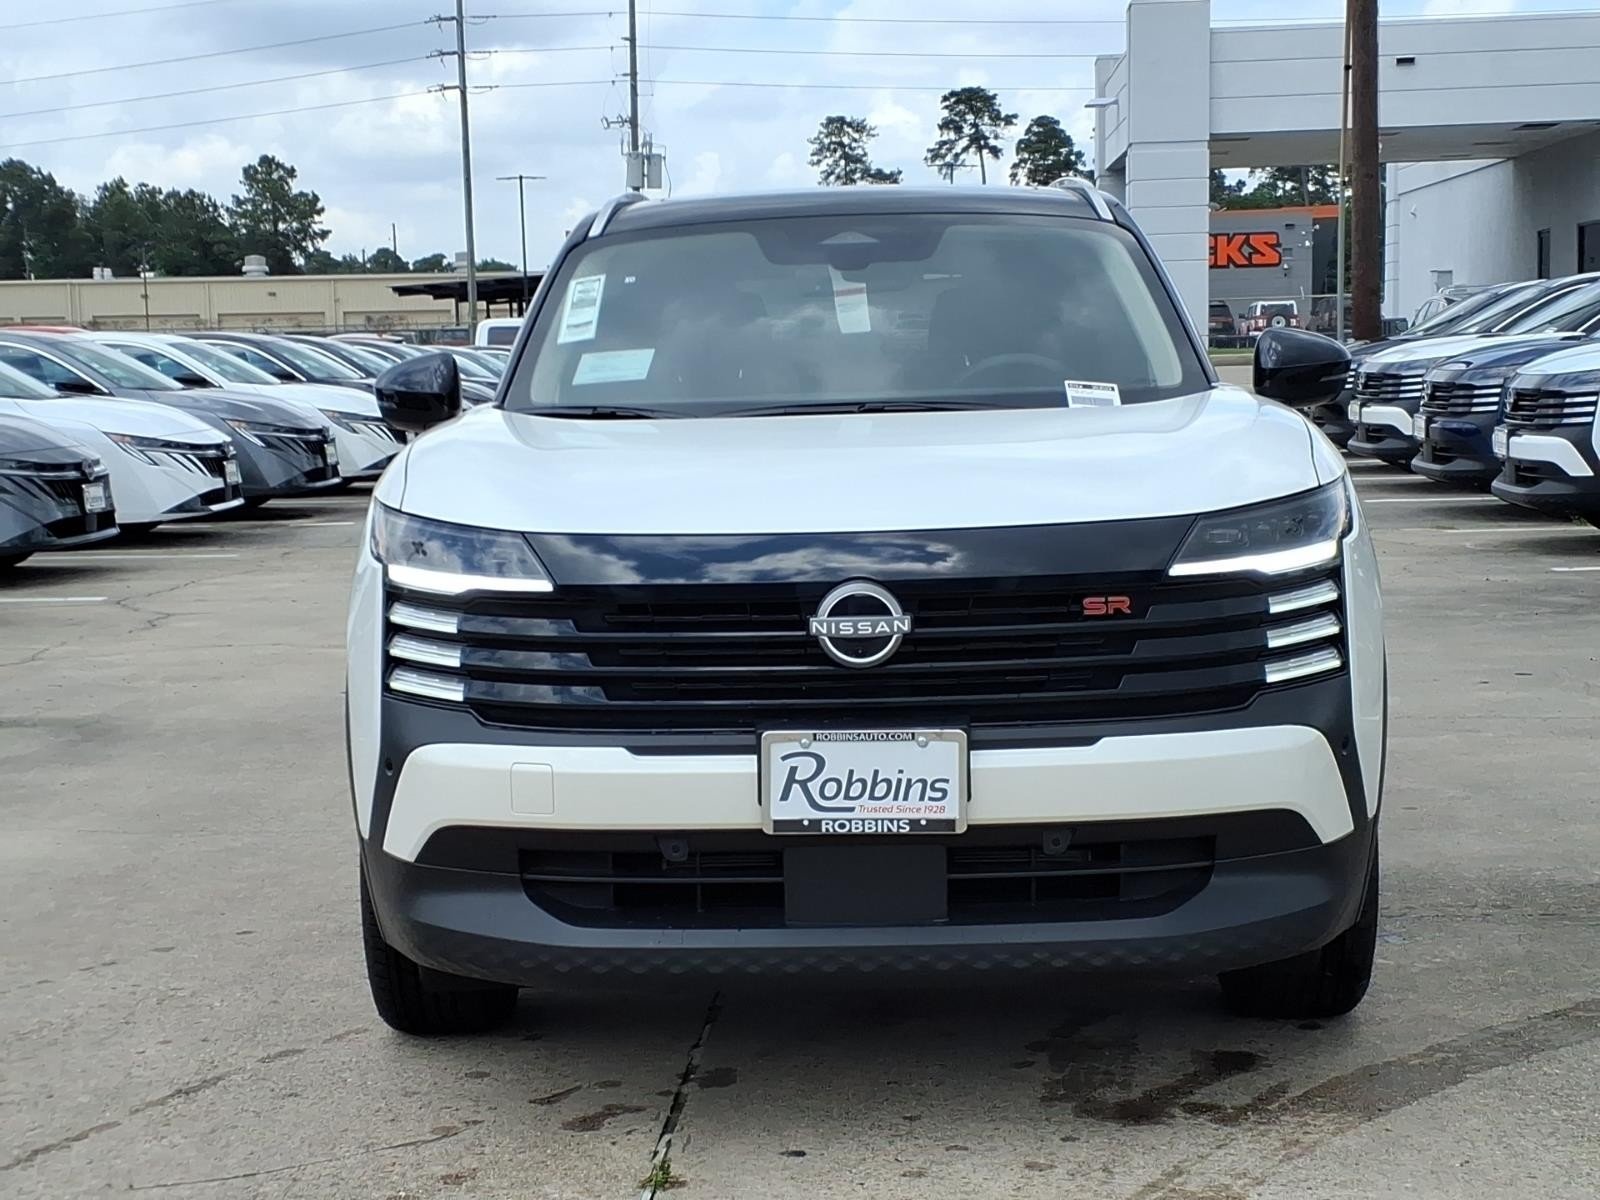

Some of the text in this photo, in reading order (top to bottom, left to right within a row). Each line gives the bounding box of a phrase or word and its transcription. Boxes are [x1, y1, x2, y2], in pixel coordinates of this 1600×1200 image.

[1209, 234, 1280, 265] KS
[1083, 596, 1131, 615] SR
[812, 619, 909, 635] NISSAN
[816, 732, 912, 741] ROBBINSAUTO.COM
[779, 751, 950, 812] Robbins
[859, 804, 946, 814] Trusted Since 1928
[821, 820, 911, 832] ROBBINS
